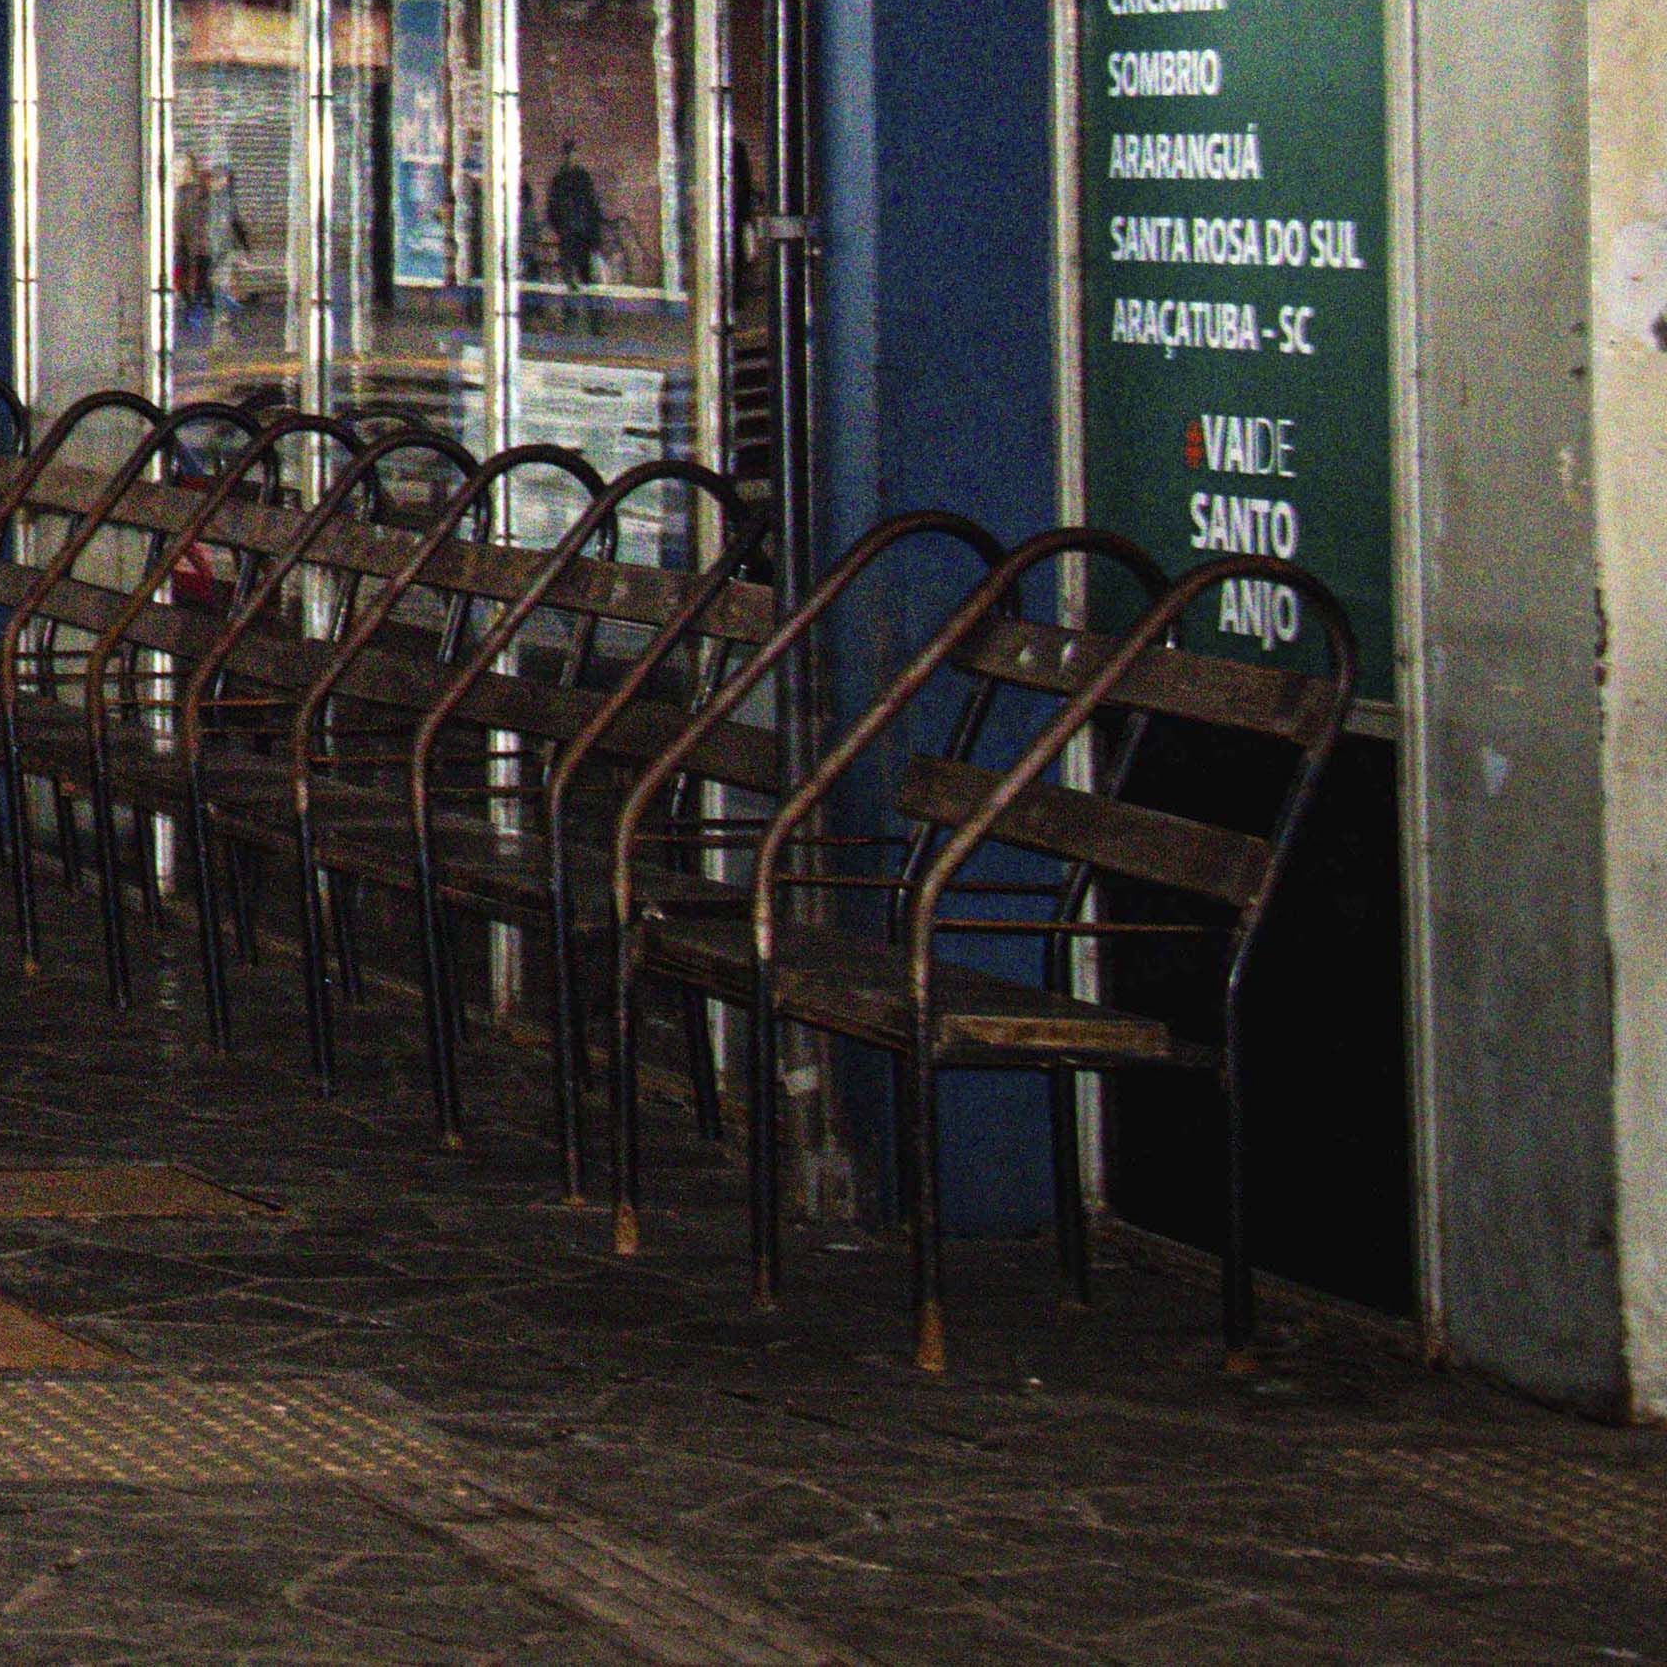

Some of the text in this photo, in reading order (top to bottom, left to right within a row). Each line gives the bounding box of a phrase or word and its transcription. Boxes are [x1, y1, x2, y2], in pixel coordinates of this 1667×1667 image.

[1106, 48, 1222, 98] SOMBRIO
[1108, 122, 1262, 180] ARARANGUÁ
[1110, 215, 1365, 270] SANTA ROSA DO SUL
[1112, 296, 1261, 359] ARAÇATUBA
[1278, 306, 1315, 355] SC
[1189, 492, 1298, 561] SANTO
[1218, 580, 1301, 651] ANJO
